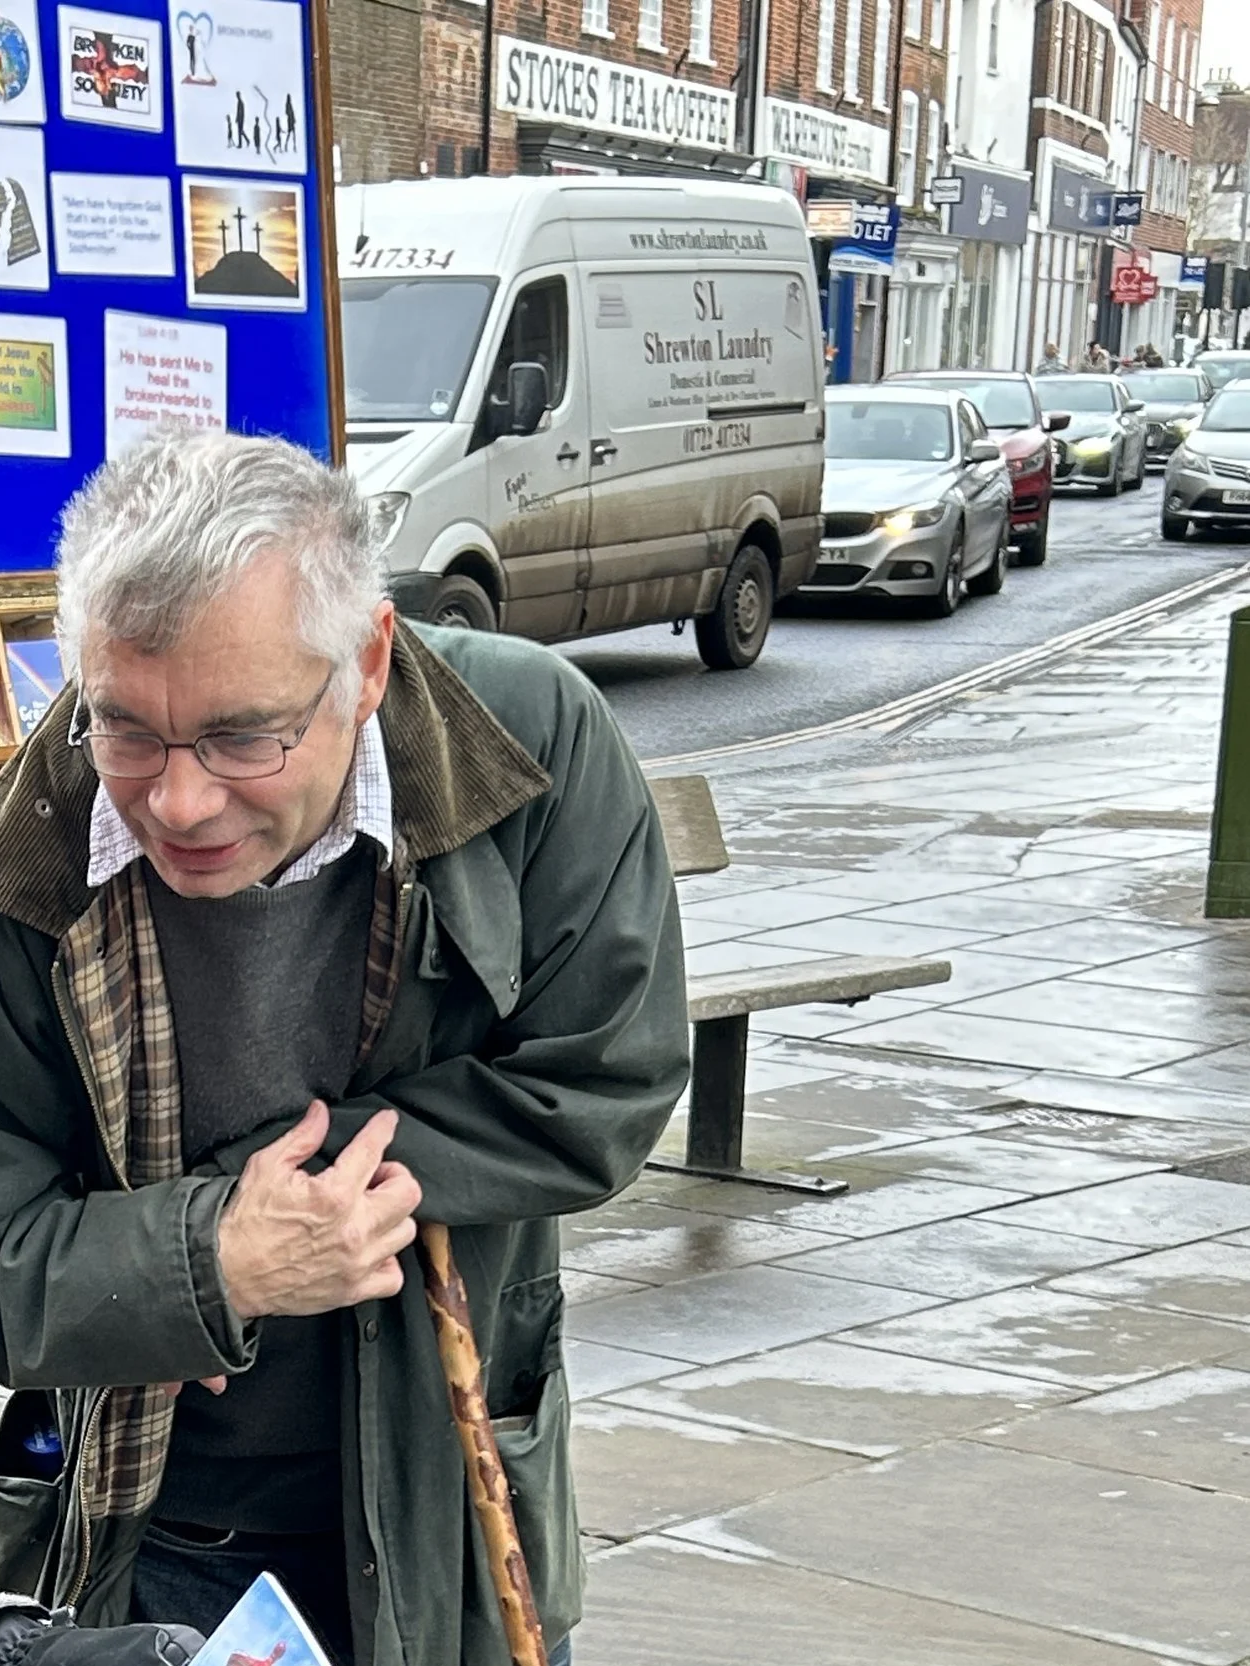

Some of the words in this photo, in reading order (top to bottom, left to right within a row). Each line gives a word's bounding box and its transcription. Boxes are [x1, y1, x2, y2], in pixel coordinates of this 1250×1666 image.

[73, 35, 145, 62] BRKEN
[74, 76, 147, 101] SOIETY
[507, 48, 598, 120] STOKES
[610, 70, 647, 130] TEA
[663, 84, 730, 145] COFFEE
[864, 224, 893, 242] LET
[349, 248, 455, 269] 417334
[643, 331, 713, 364] Shrewton
[717, 328, 774, 364] Laundry
[120, 349, 135, 365] He
[137, 350, 156, 367] has
[160, 357, 182, 369] sent
[184, 357, 201, 372] Me
[203, 359, 213, 373] to
[148, 371, 170, 387] heal
[173, 373, 189, 388] the
[125, 386, 199, 408] brokenhearted
[202, 395, 212, 410] to
[114, 406, 158, 420] proclaim
[195, 413, 204, 426] to
[207, 414, 222, 427] the
